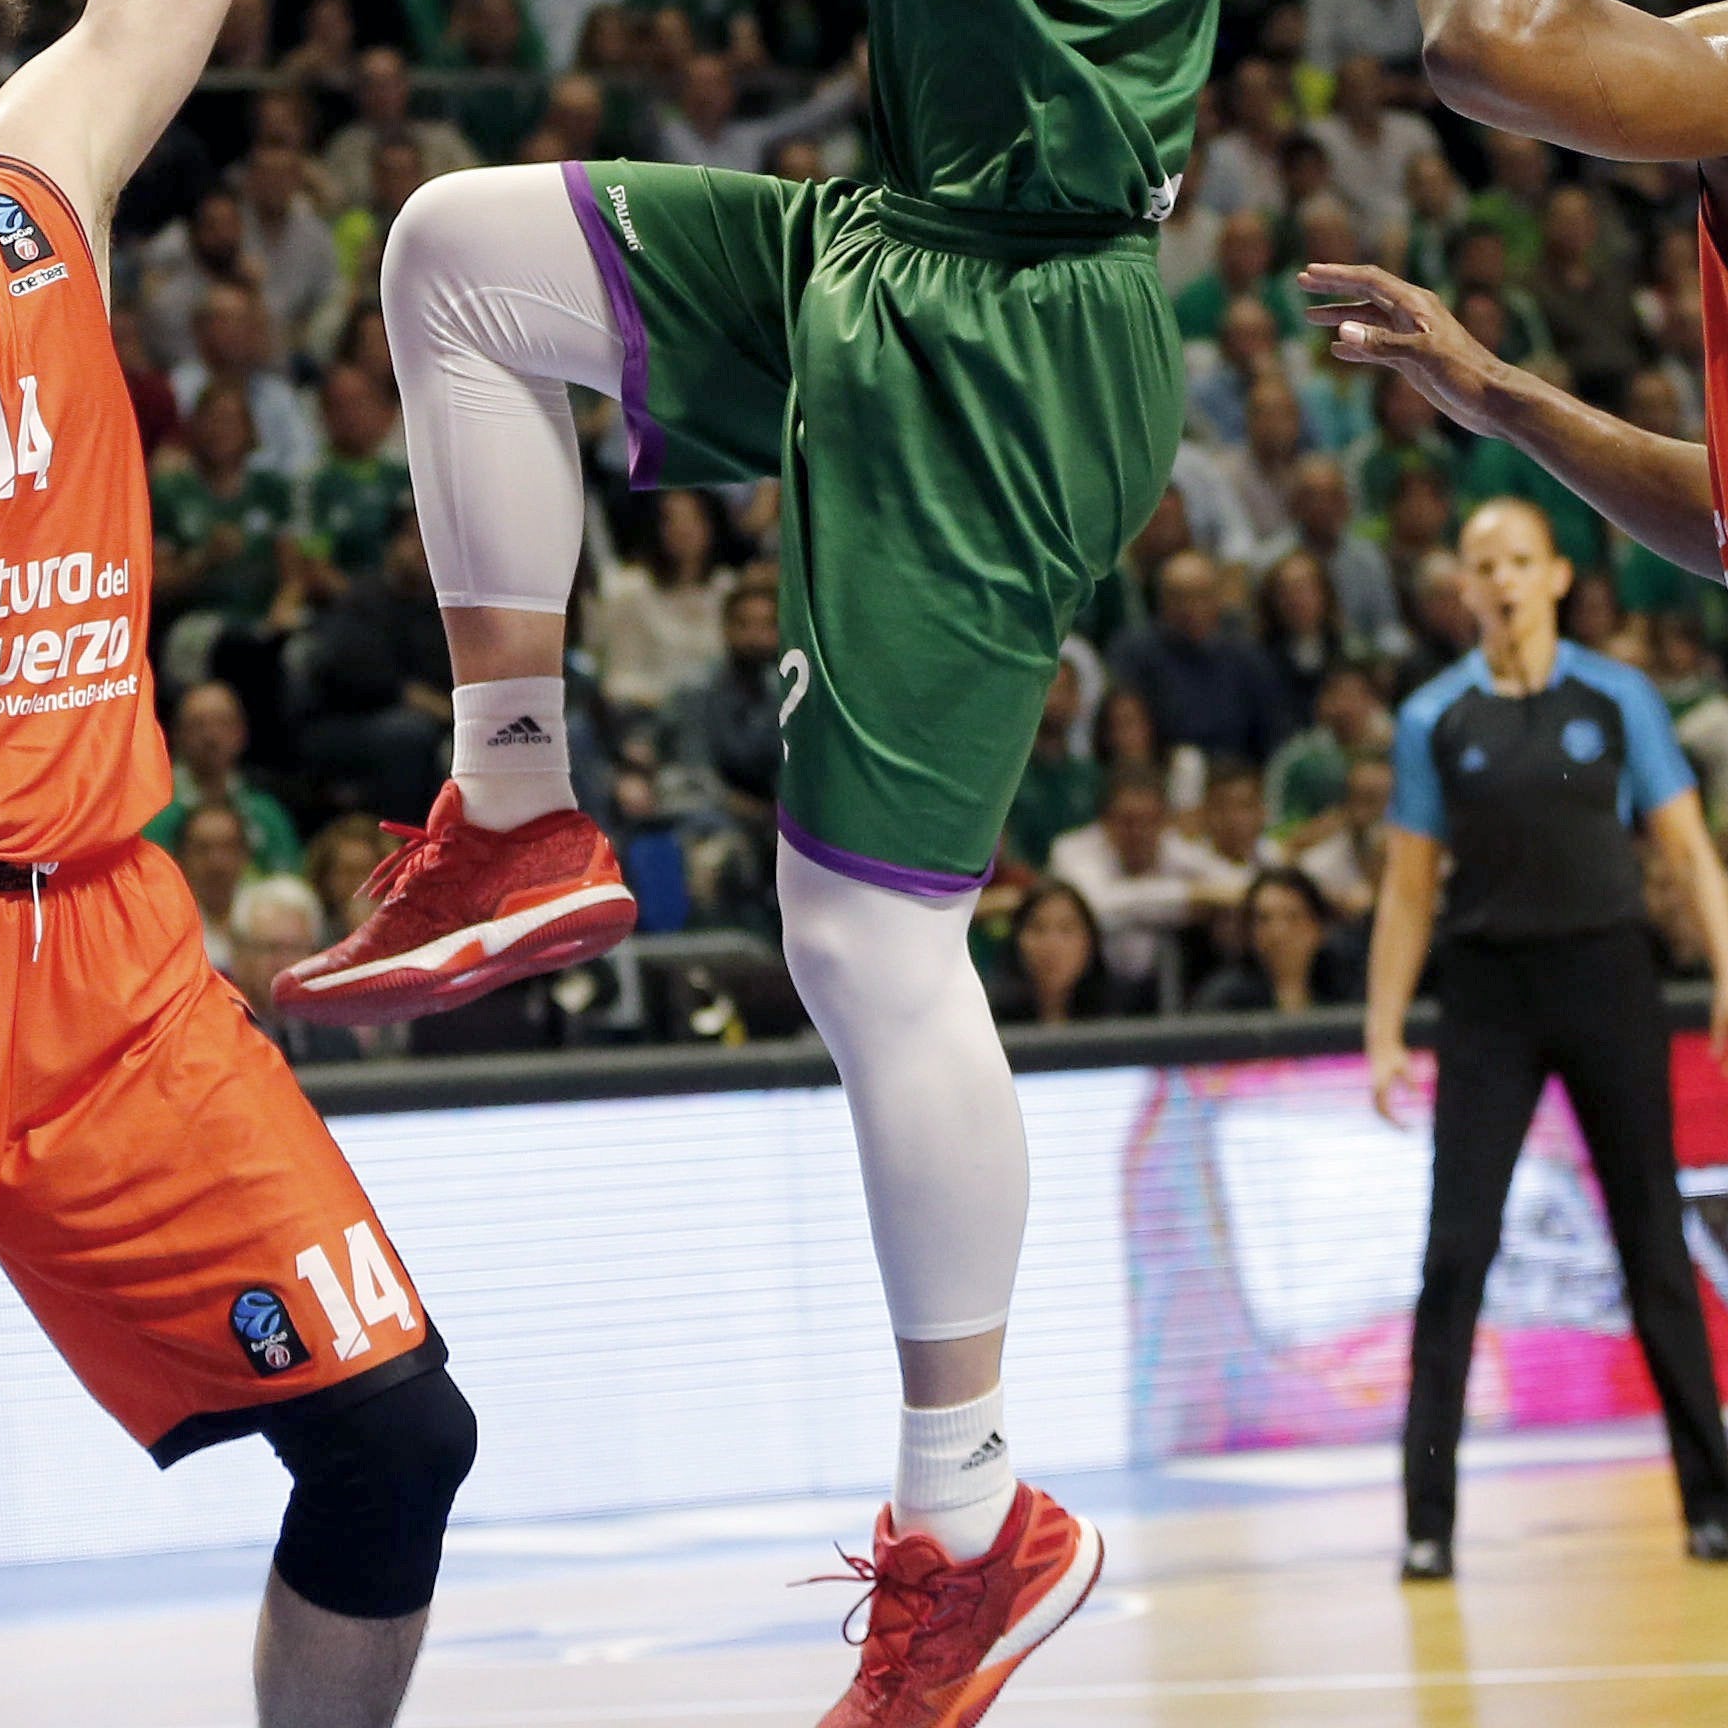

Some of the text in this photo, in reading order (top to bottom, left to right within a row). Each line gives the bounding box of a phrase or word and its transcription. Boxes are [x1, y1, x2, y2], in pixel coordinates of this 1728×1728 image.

[605, 184, 644, 252] SPALDING
[96, 558, 129, 600] del
[487, 732, 552, 747] adidas
[295, 1219, 417, 1361] 14
